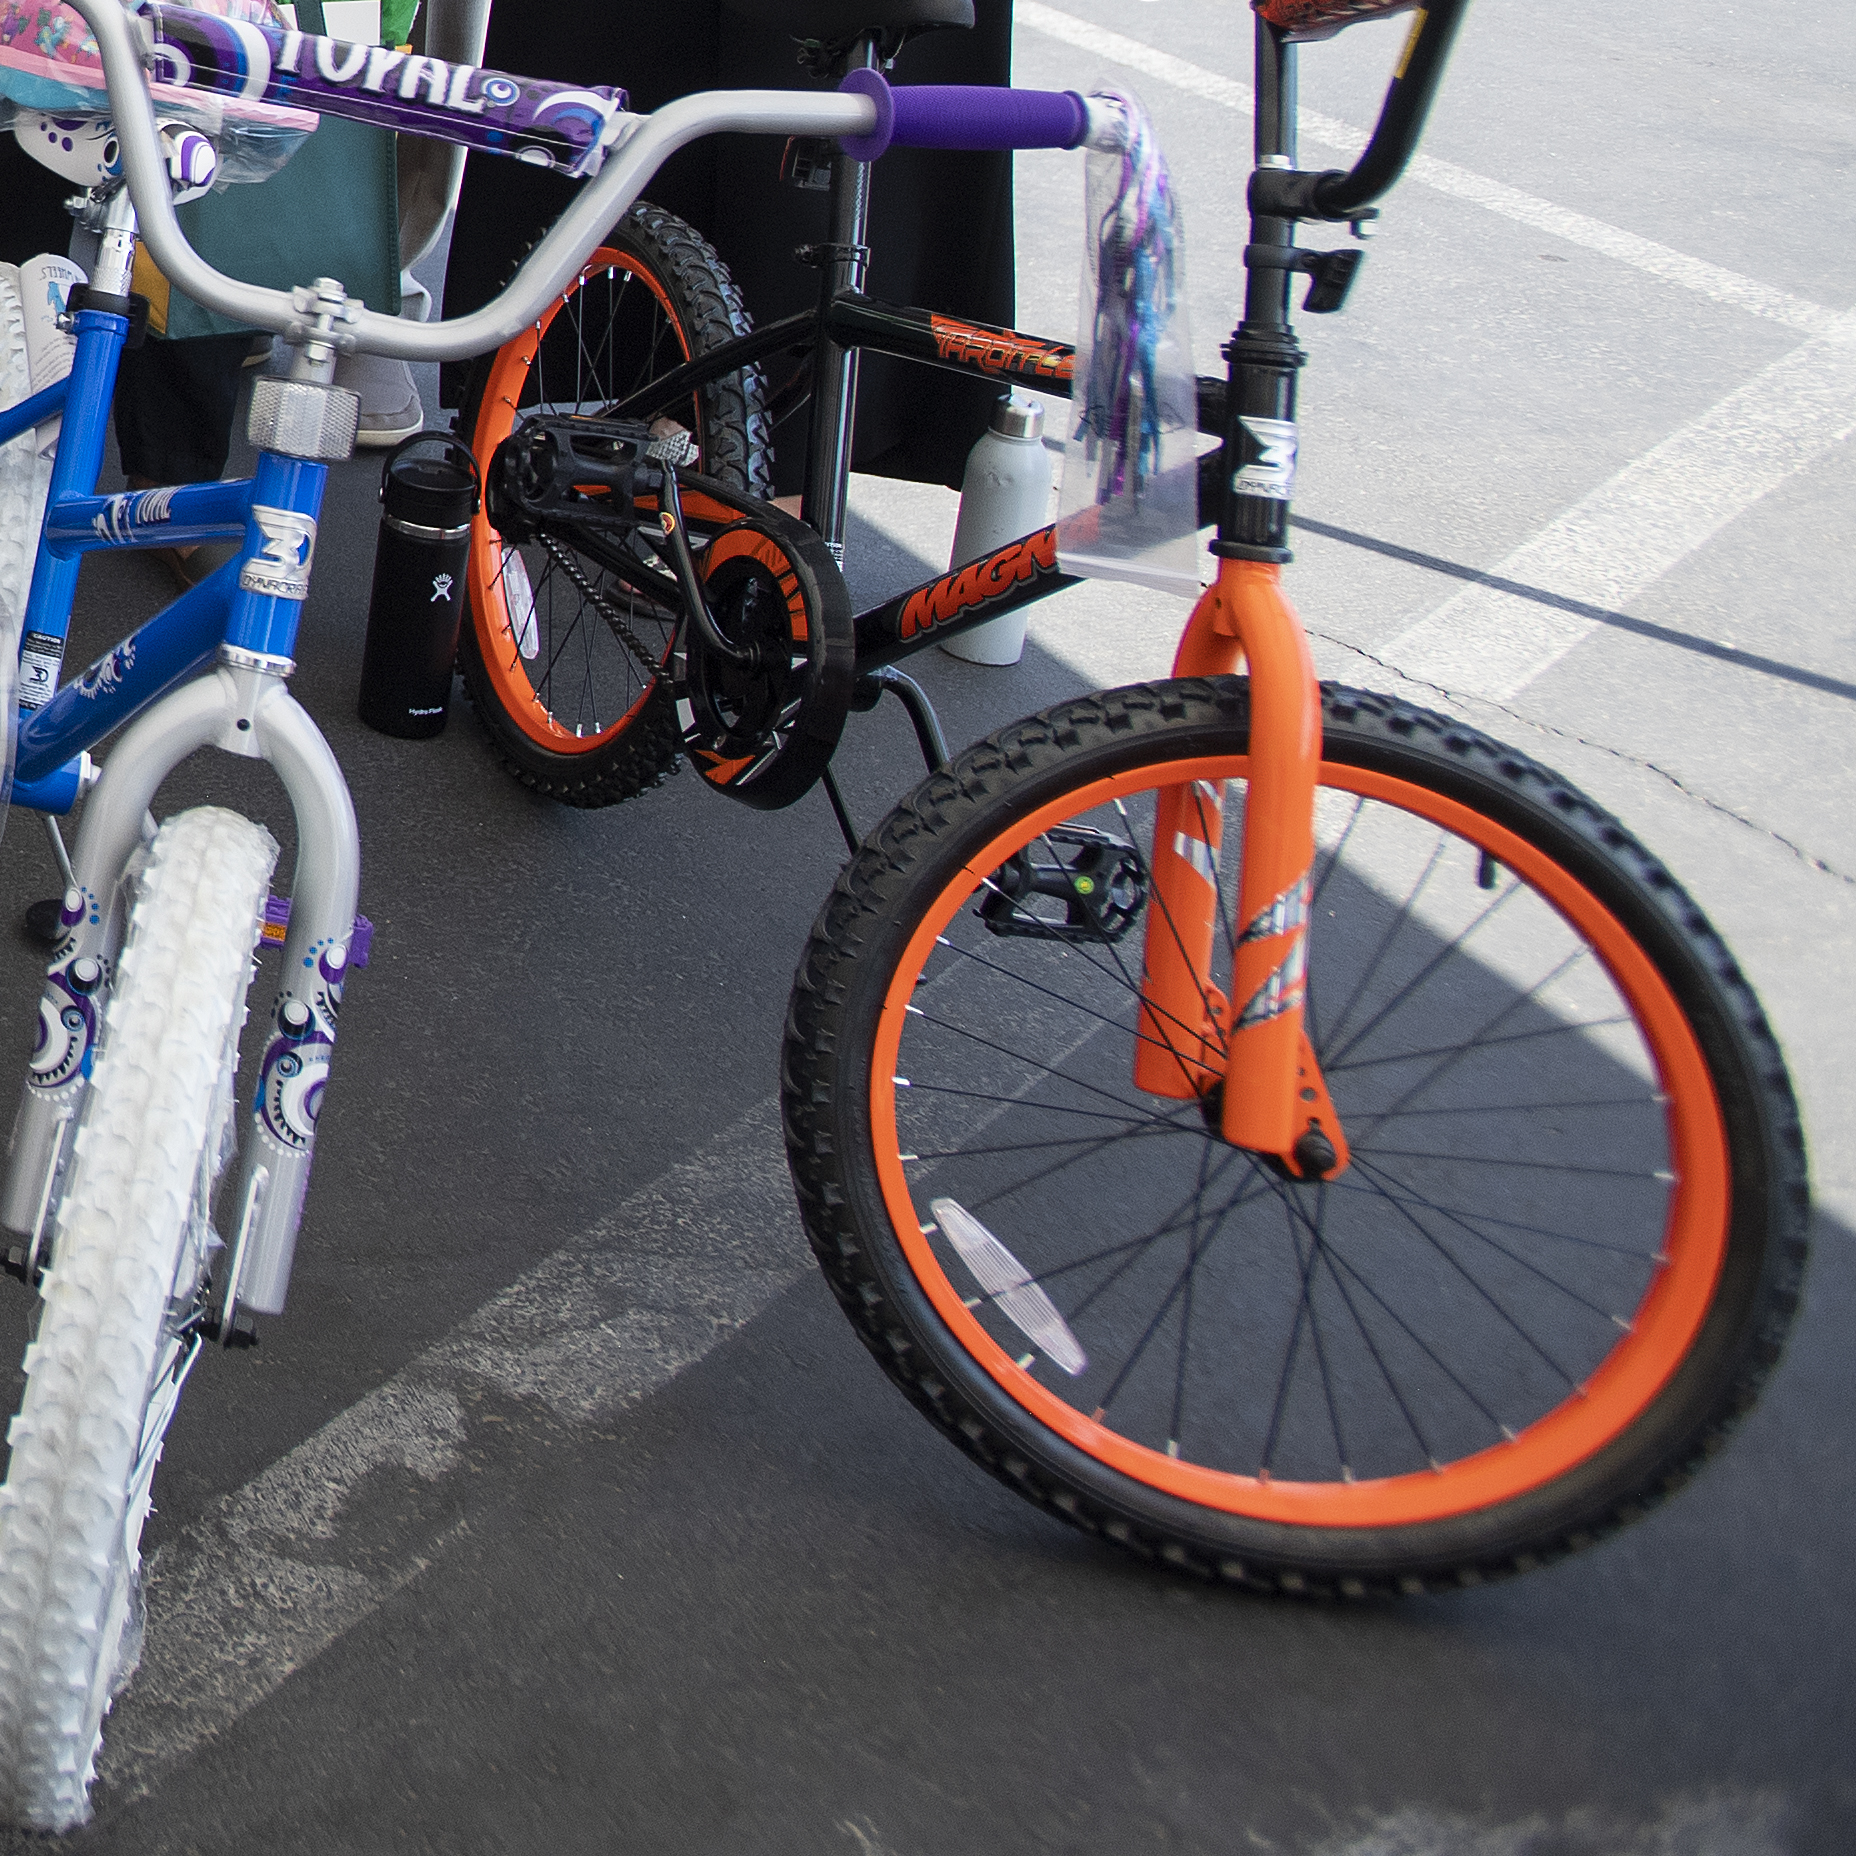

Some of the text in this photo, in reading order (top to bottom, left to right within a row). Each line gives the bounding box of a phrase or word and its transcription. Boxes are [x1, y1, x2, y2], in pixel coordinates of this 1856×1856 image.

[897, 528, 1059, 643] MAGN
[408, 706, 444, 717] Hydro Flask
